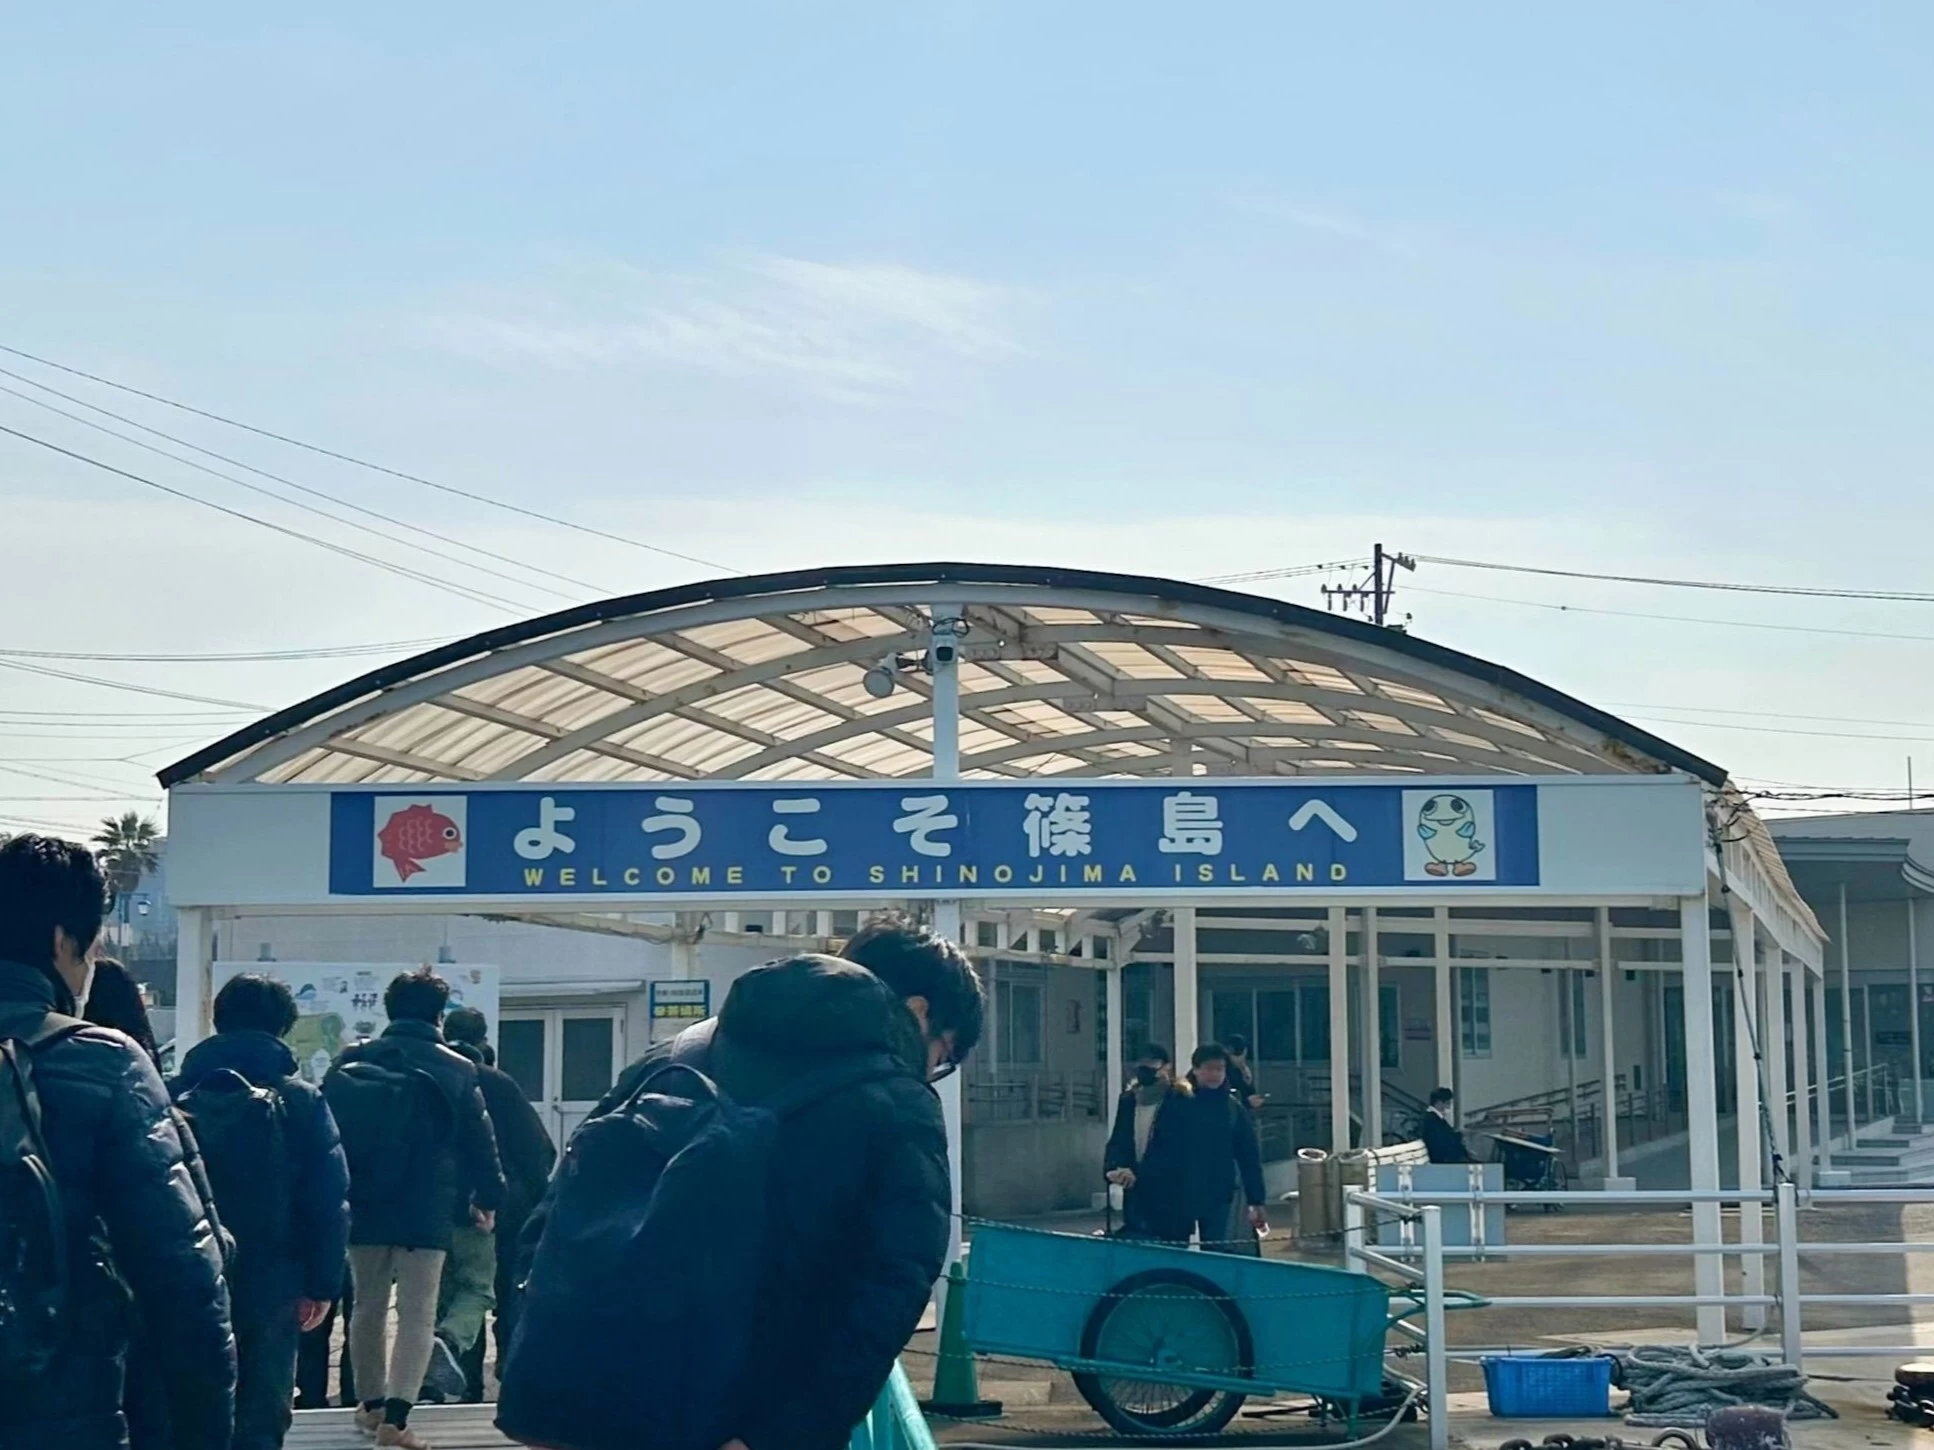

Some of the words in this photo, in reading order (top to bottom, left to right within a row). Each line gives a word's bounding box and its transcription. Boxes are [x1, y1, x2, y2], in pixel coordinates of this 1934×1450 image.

[514, 791, 1358, 860] ようこそ篠島へ
[524, 867, 743, 886] WELCOME
[781, 866, 832, 885] TO
[869, 864, 1136, 884] SHINOJIMA
[1174, 863, 1348, 882] ISLAND
